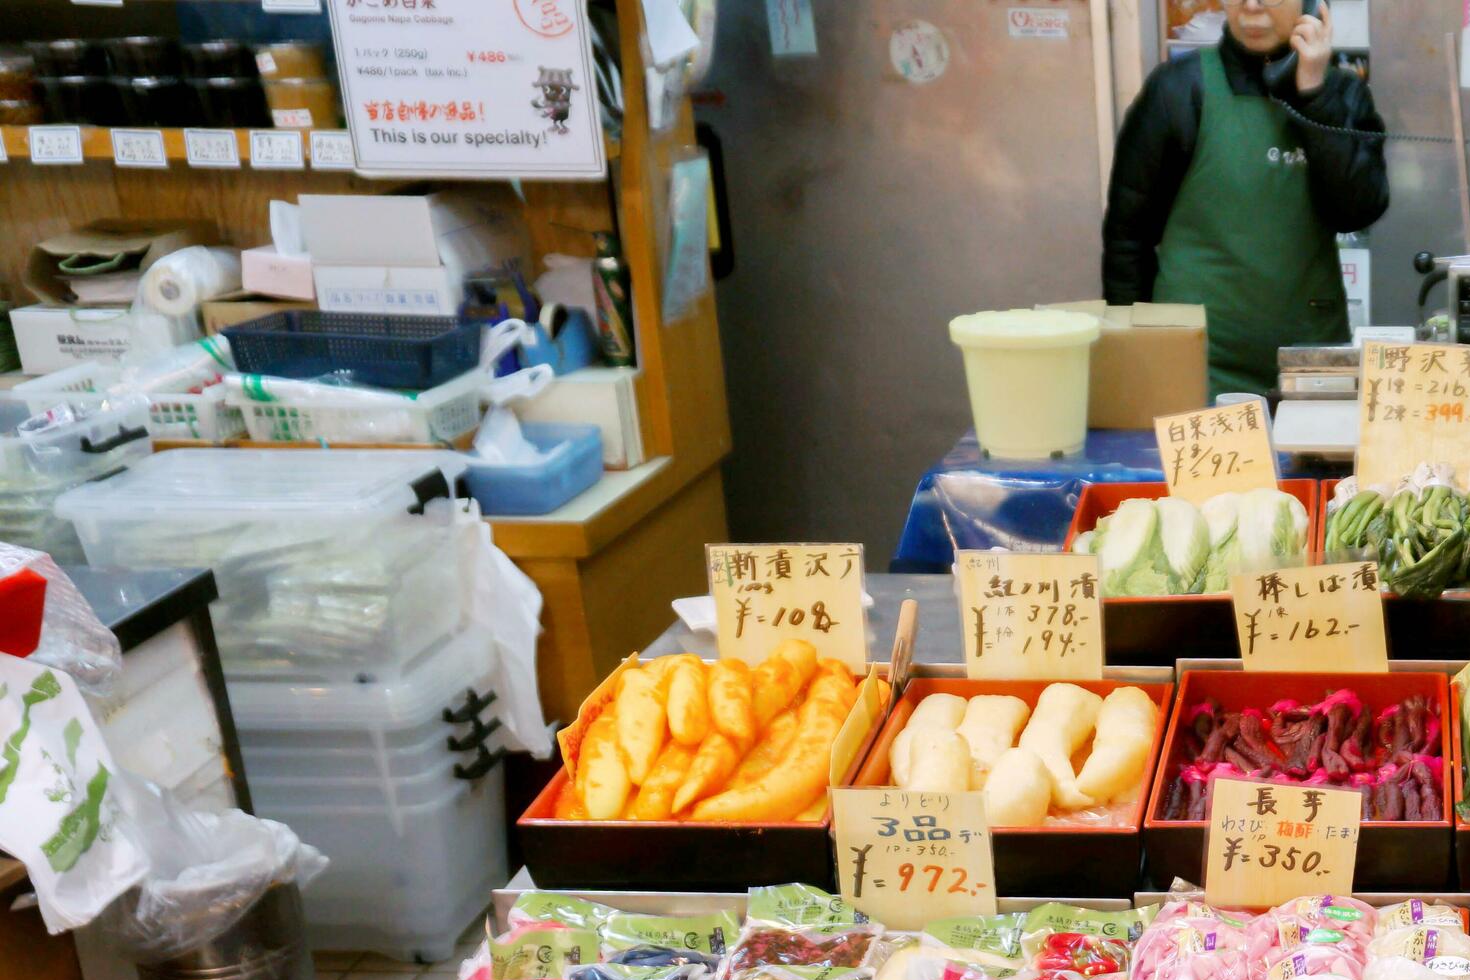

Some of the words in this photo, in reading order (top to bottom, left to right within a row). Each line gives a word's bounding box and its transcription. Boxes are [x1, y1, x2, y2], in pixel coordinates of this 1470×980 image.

[370, 128, 407, 144] This
[412, 129, 426, 144] is
[432, 132, 457, 145] our
[465, 128, 548, 148] specialty!
[1168, 405, 1259, 442] 白菜浅漬
[1256, 562, 1378, 603] 棒しば漬
[880, 793, 950, 811] よりどり
[1247, 787, 1326, 823] 長芋
[1222, 815, 1264, 834] わさび
